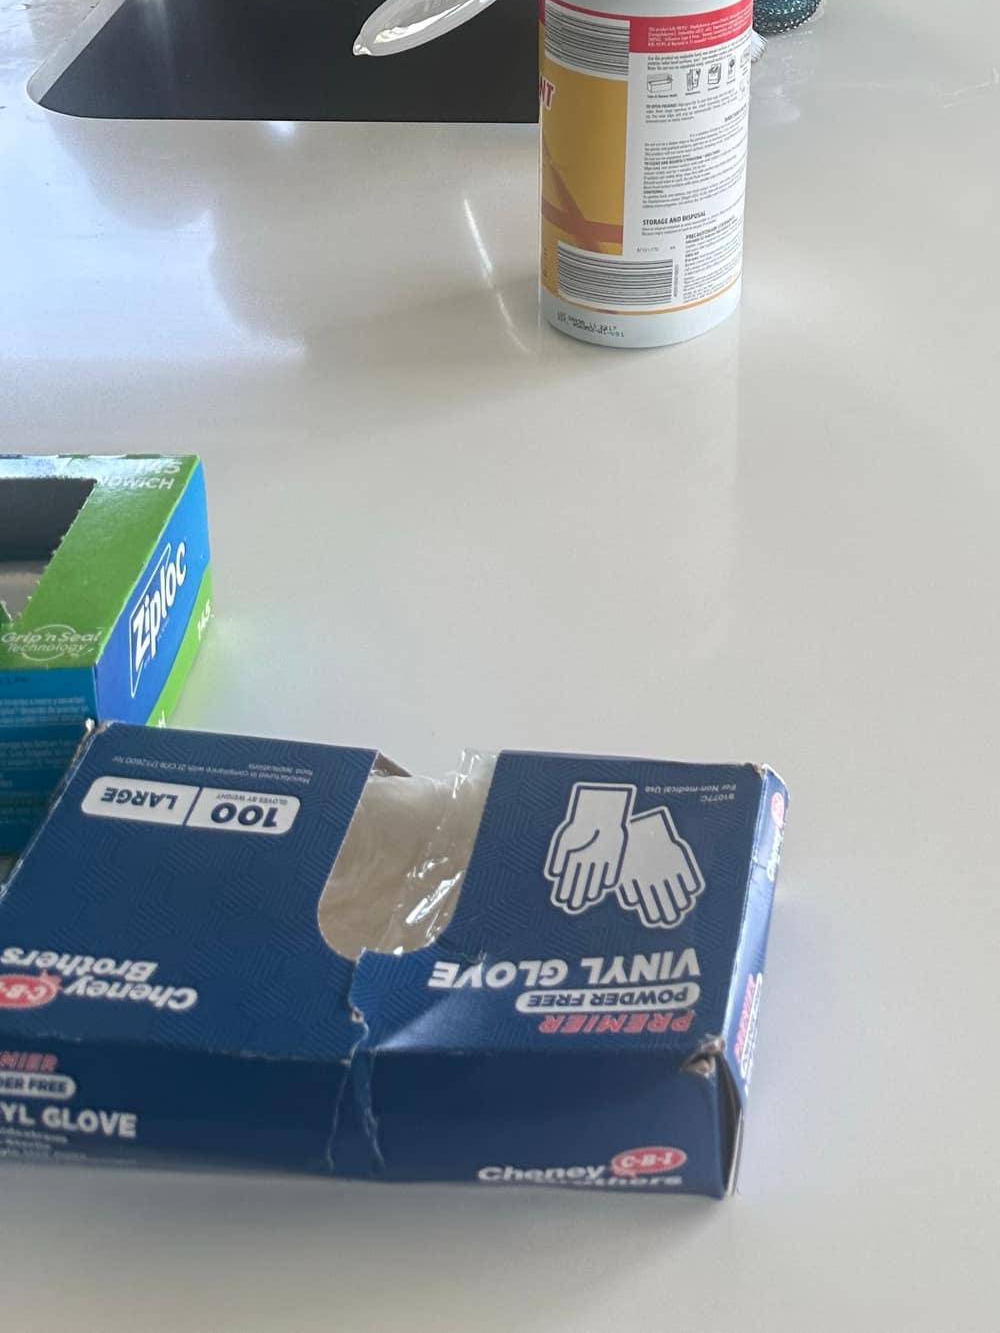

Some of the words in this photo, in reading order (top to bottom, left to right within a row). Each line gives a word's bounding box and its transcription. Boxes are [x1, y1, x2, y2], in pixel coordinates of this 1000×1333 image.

[642, 215, 668, 226] STORAGE
[669, 214, 682, 224] AND
[682, 210, 706, 222] DISPOSAL
[131, 541, 187, 672] Ziploc
[1, 632, 41, 645] Grip
[58, 630, 103, 643] Seal
[7, 642, 88, 654] Technology
[100, 786, 179, 811] LARGE
[215, 793, 247, 803] WEIGHT
[247, 794, 258, 803] BY
[258, 795, 289, 806] GLOVES
[210, 801, 281, 829] 100
[1, 946, 159, 983] Brothers
[427, 958, 570, 989] GLOVE
[580, 947, 701, 987] VINYL
[64, 976, 198, 1010] Cheney
[526, 992, 586, 1008] FREE
[588, 987, 689, 1008] POWDER
[537, 1009, 696, 1035] PREMIER
[28, 1077, 68, 1093] FREE
[41, 1106, 138, 1139] GLOVE
[477, 1164, 607, 1182] Cheney
